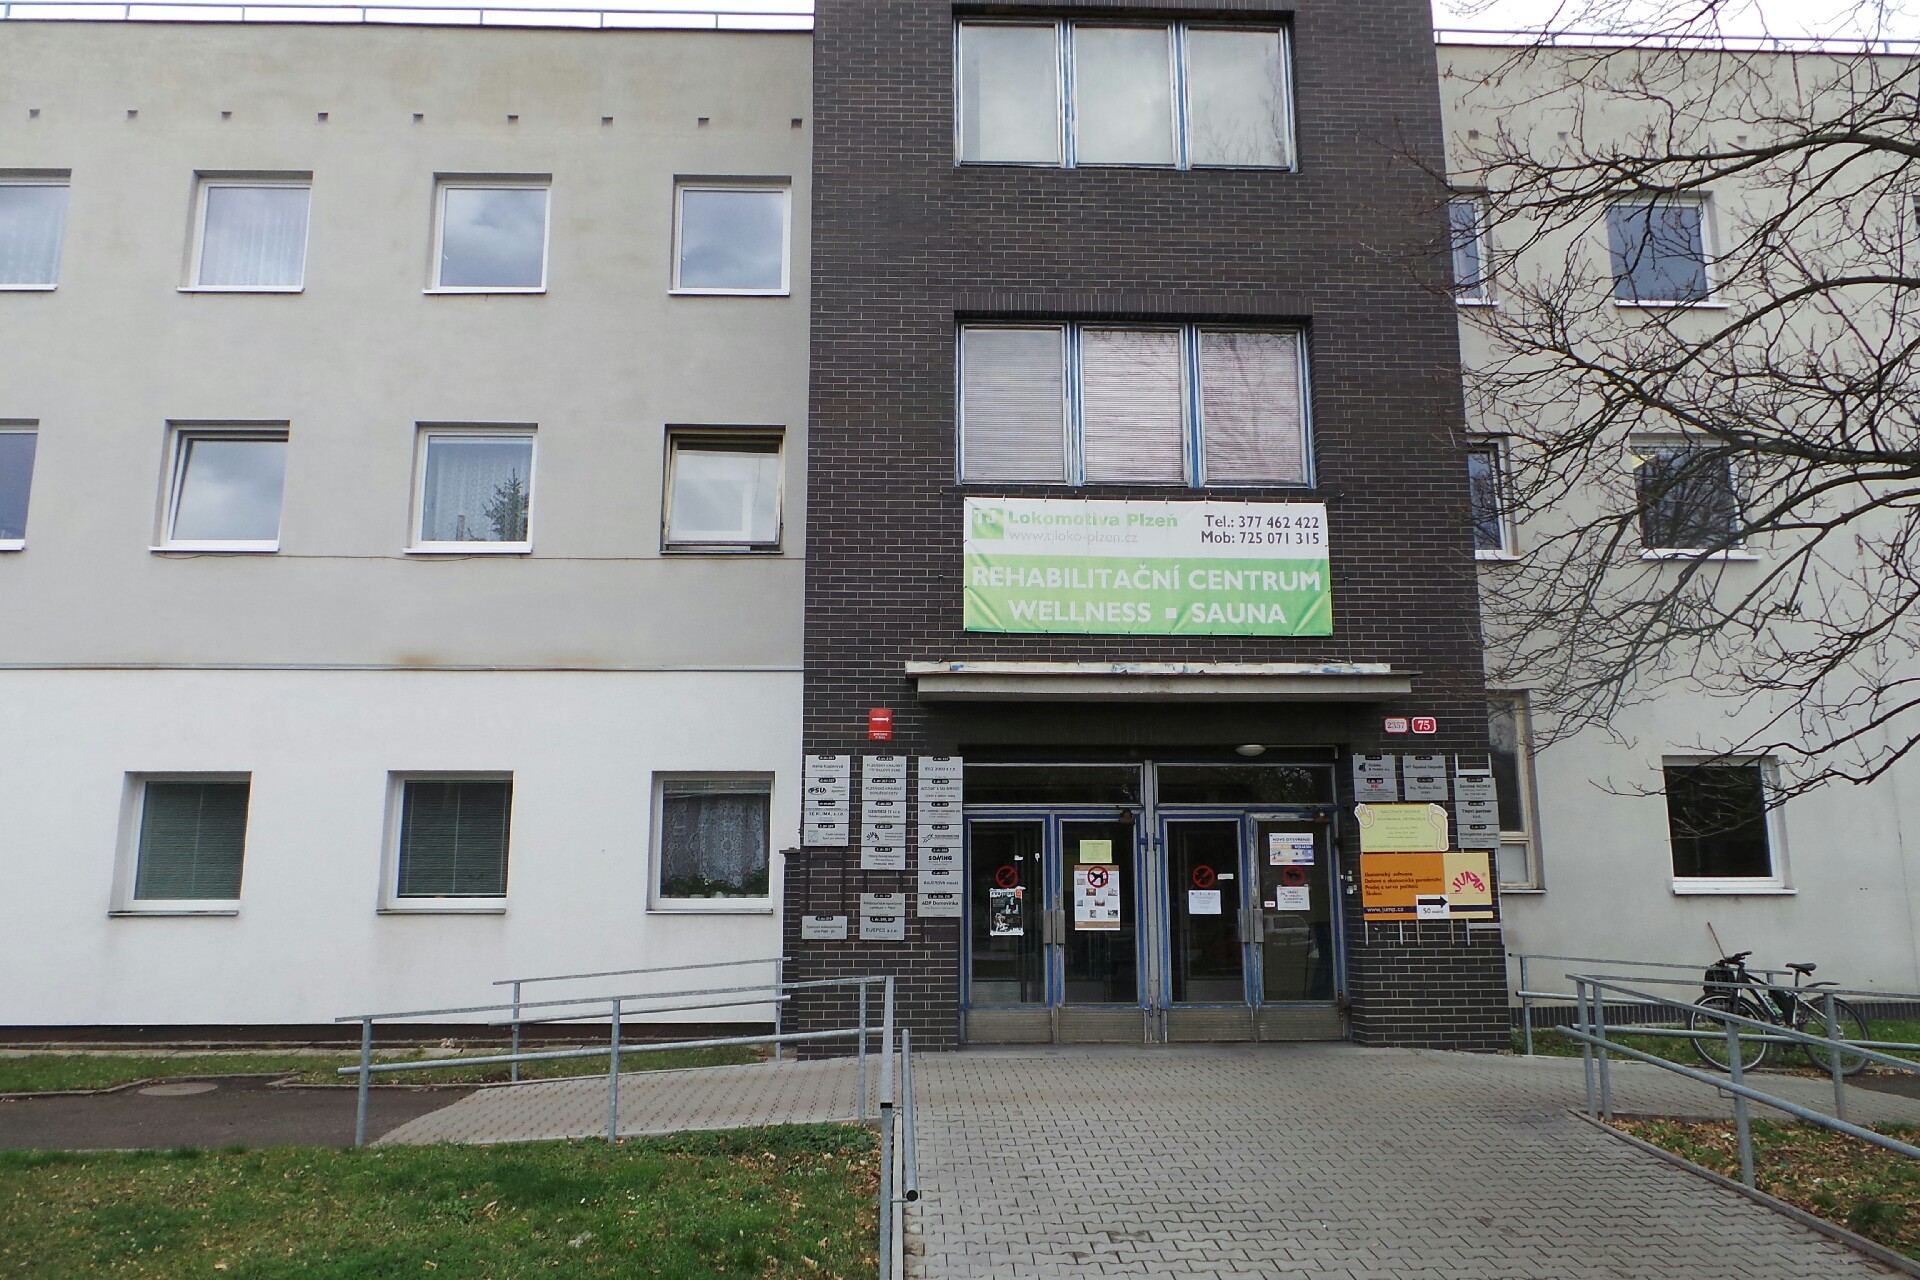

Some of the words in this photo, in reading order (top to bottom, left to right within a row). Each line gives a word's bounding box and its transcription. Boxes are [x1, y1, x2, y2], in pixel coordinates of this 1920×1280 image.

[1008, 511, 1120, 527] Lokomotiva
[1126, 513, 1178, 528] Plzeň
[1204, 514, 1234, 528] Tel.:
[1239, 515, 1262, 528] 377
[1266, 516, 1291, 529] 462
[1295, 516, 1320, 529] 422
[1009, 531, 1139, 544] www.tjloko-plzen.cz
[1201, 531, 1235, 544] Mob:
[1239, 532, 1263, 544] 725
[1267, 532, 1289, 544] 071
[1295, 533, 1320, 545] 315
[972, 564, 1181, 590] REHABILITAČNÍ
[1188, 569, 1321, 591] CENTRUM
[1007, 600, 1152, 623] WELLNESS
[1191, 602, 1288, 624] SAUNA
[1387, 721, 1405, 729] 2357
[1417, 720, 1431, 731] 75
